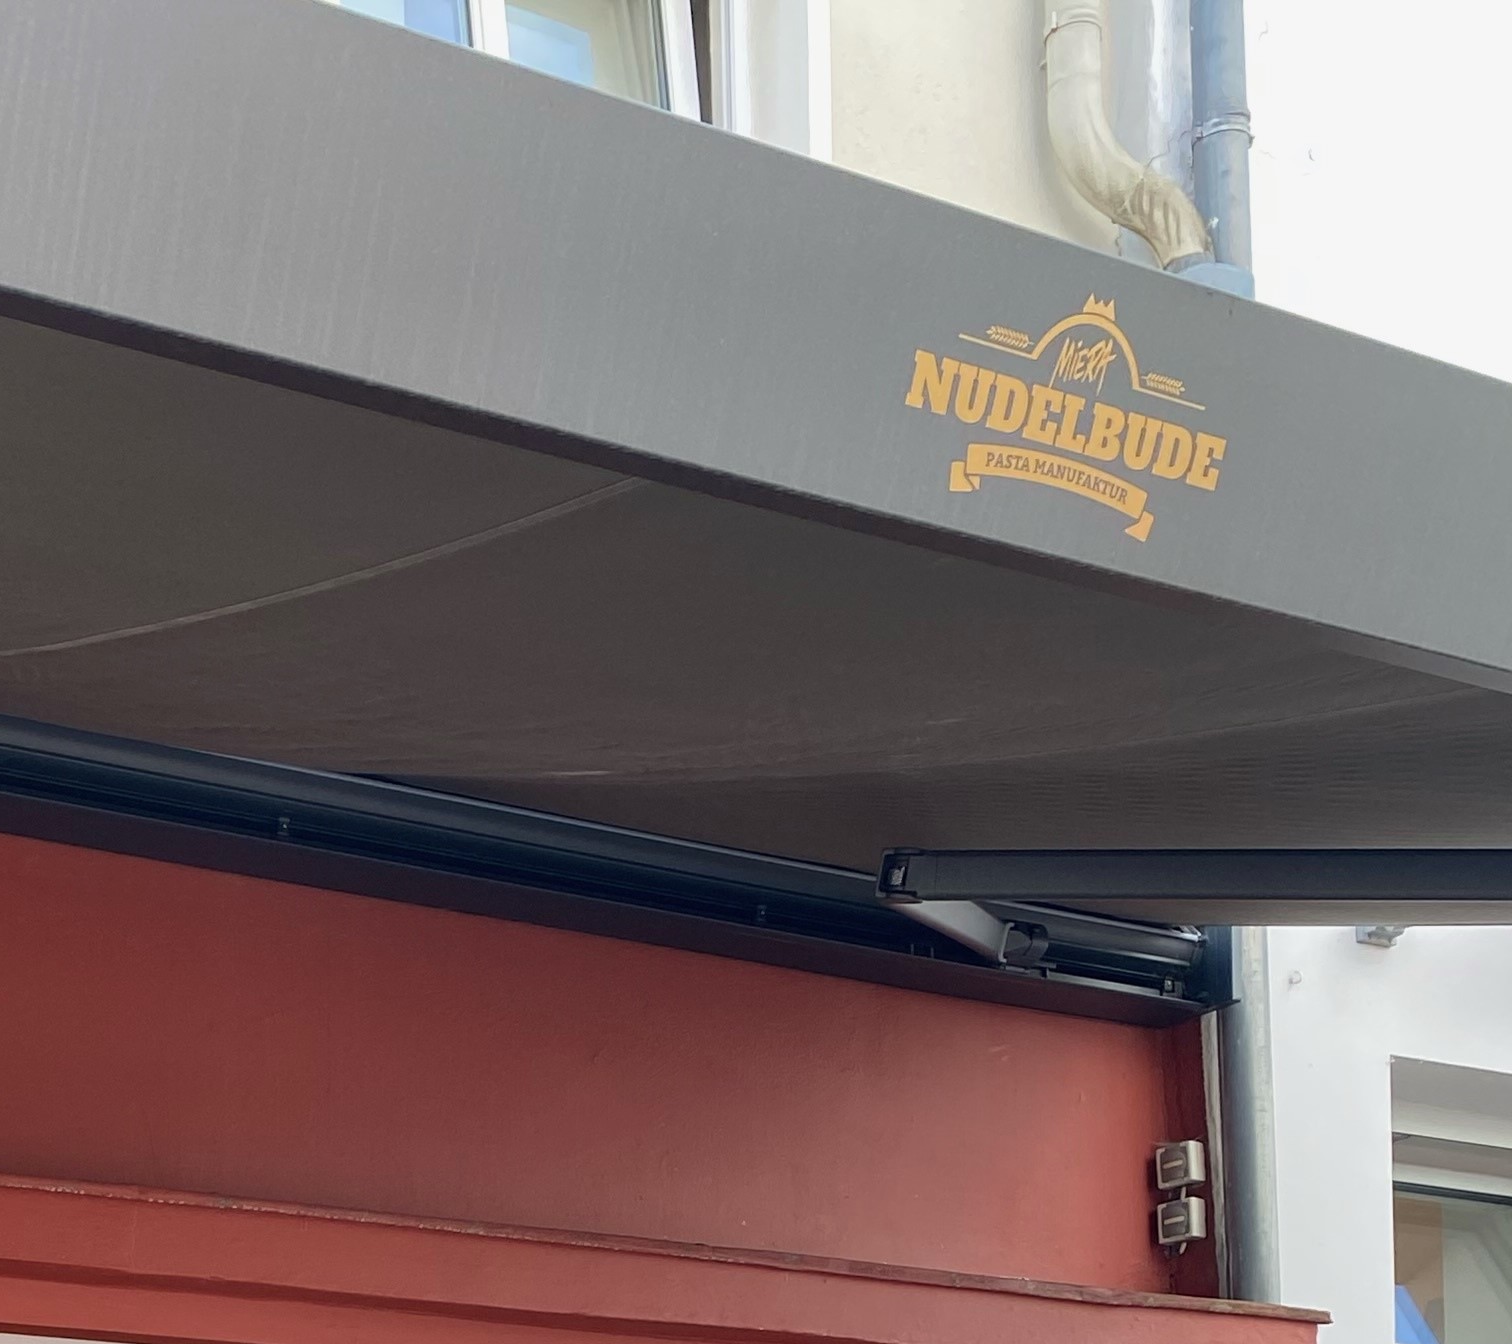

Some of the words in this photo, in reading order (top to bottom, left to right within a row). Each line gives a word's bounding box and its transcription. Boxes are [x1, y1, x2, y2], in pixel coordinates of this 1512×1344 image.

[904, 348, 1227, 491] NUDELBUDE
[985, 451, 1031, 474] PASTA
[1033, 457, 1129, 505] MANUFAKTUR
